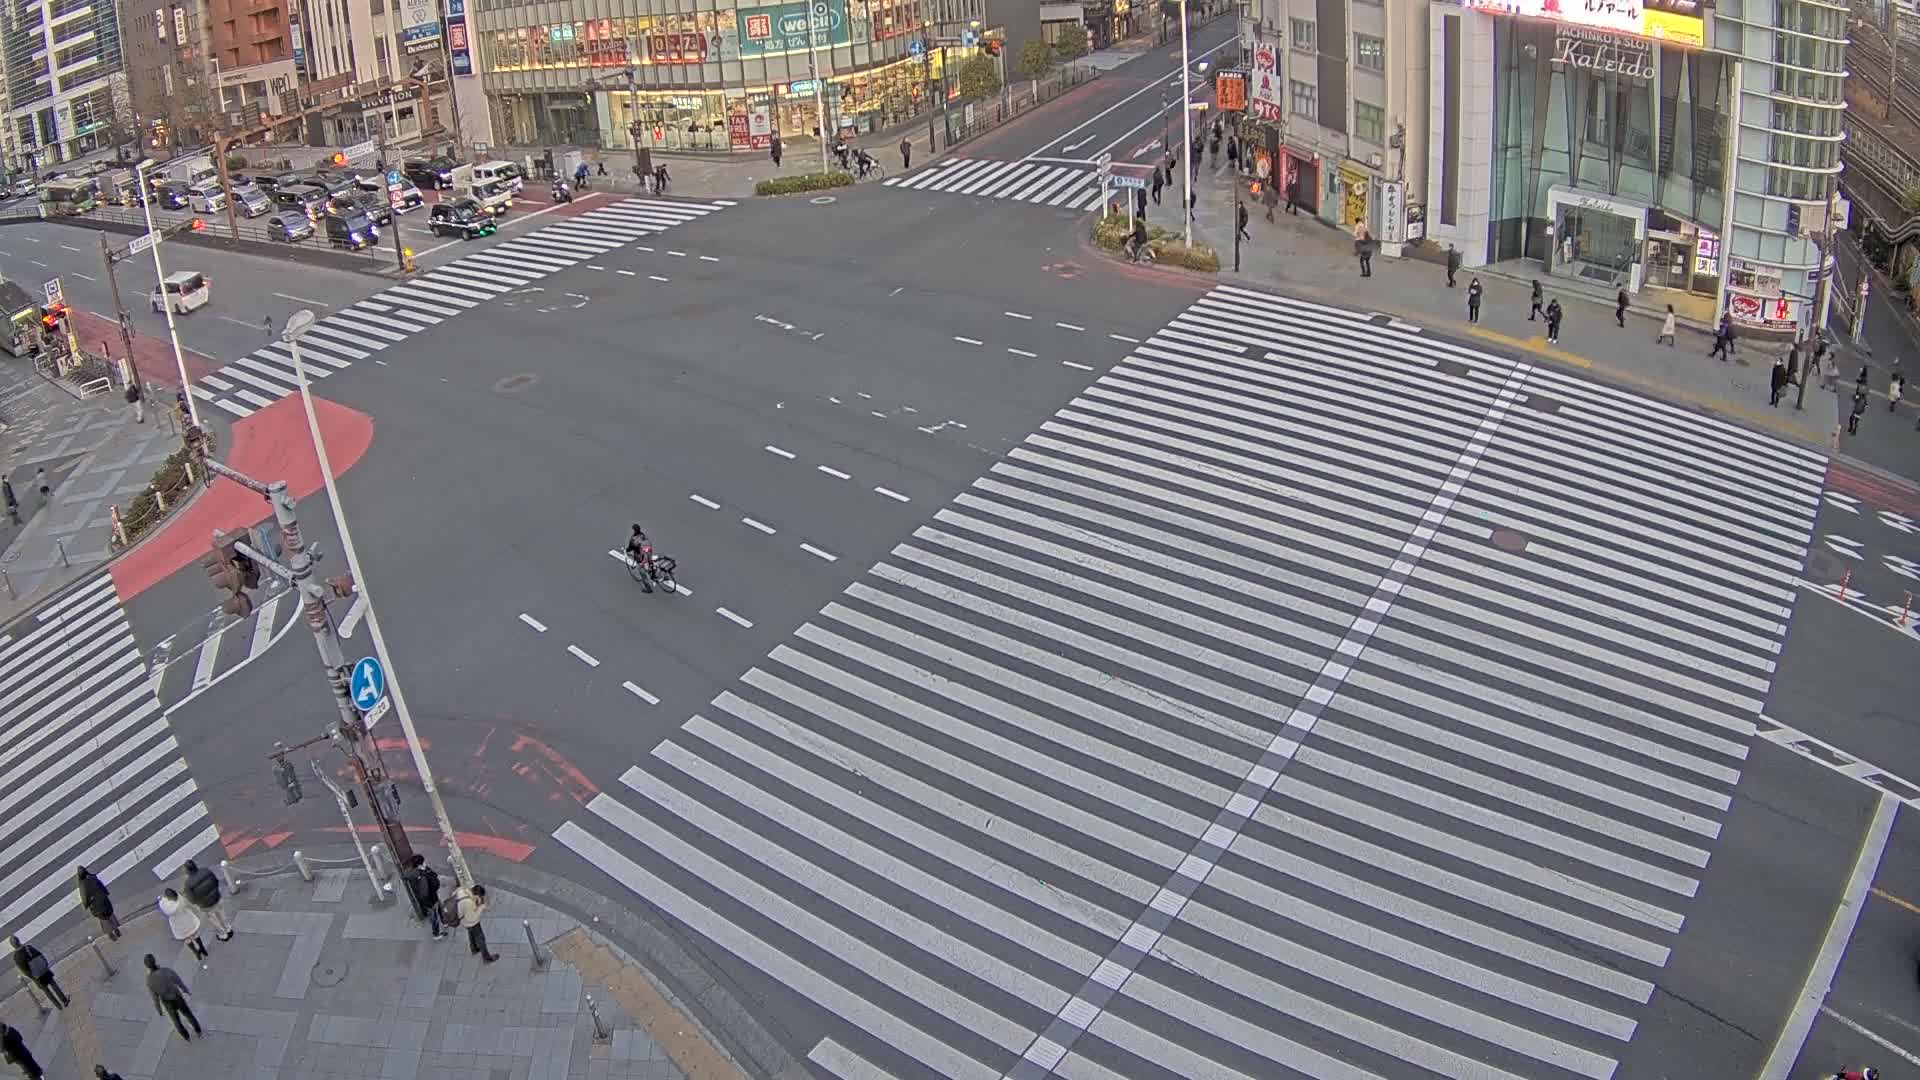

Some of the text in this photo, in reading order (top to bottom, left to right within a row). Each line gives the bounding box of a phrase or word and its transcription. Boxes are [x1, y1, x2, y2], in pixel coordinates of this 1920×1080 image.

[1584, 1, 1640, 19] ルノアール
[1555, 26, 1611, 44] PACHINKO
[1624, 37, 1651, 51] SLOT
